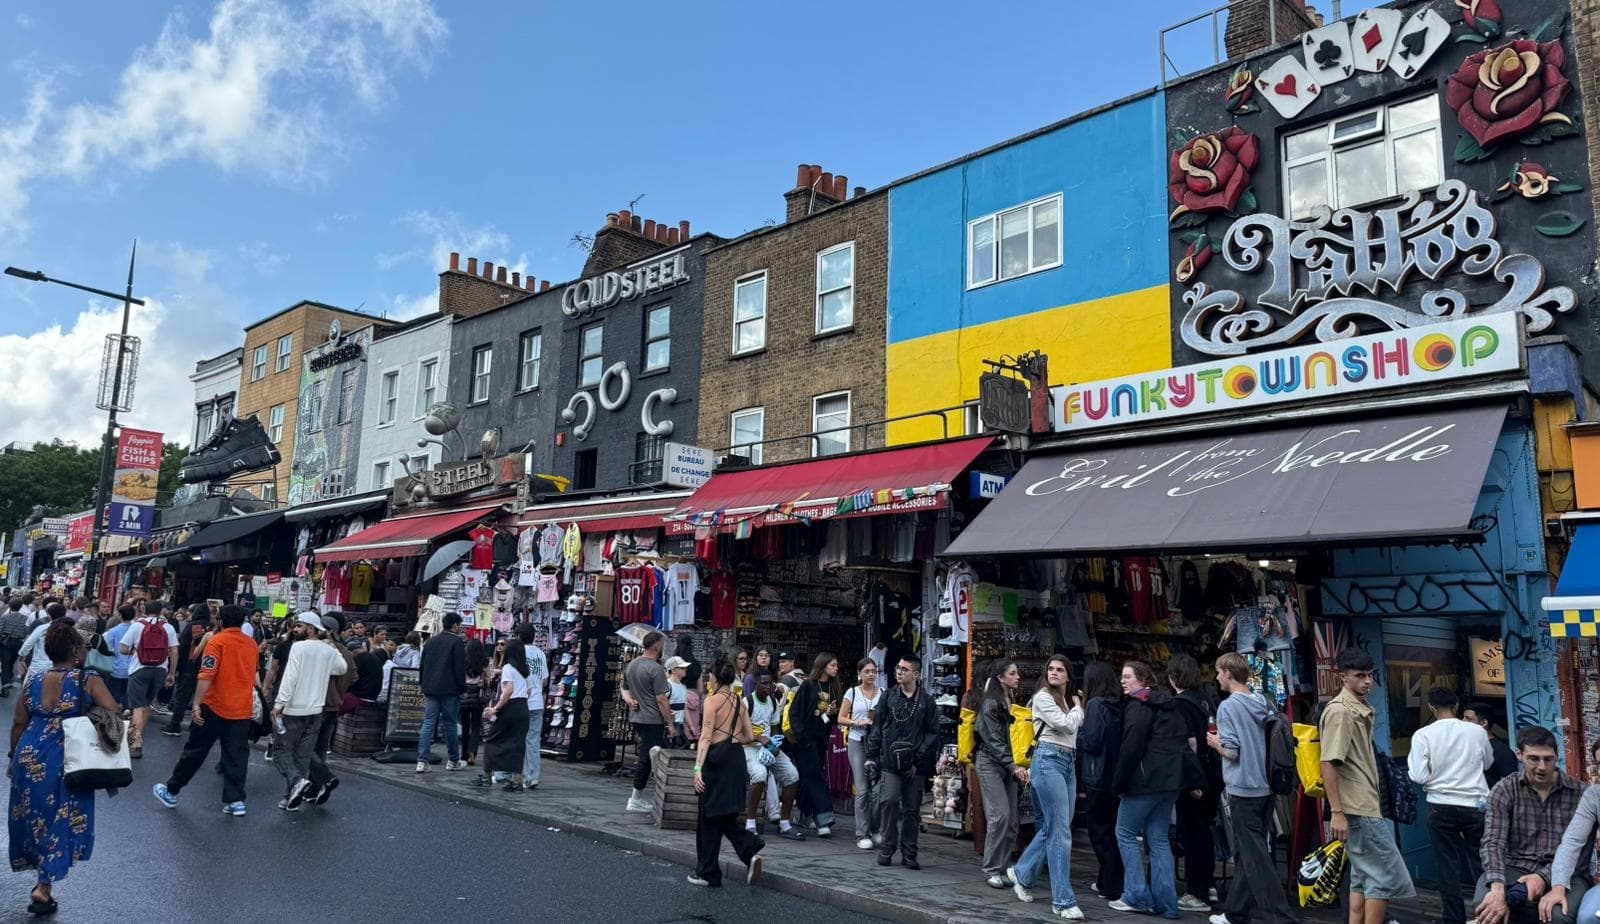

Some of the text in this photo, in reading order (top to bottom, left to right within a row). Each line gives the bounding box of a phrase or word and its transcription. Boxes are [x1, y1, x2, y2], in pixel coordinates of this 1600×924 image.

[123, 446, 147, 456] FISH
[121, 454, 156, 465] CHIPS
[677, 455, 704, 465] BUREAU
[432, 462, 490, 486] STEEL
[681, 467, 710, 478] CHANGE
[1025, 438, 1265, 497] Evil from
[1186, 457, 1242, 482] the
[982, 479, 1004, 495] ATM
[119, 521, 141, 529] 2 MIN
[621, 584, 640, 604] 80
[1487, 668, 1500, 678] OF
[578, 638, 599, 738] TATTOOS
